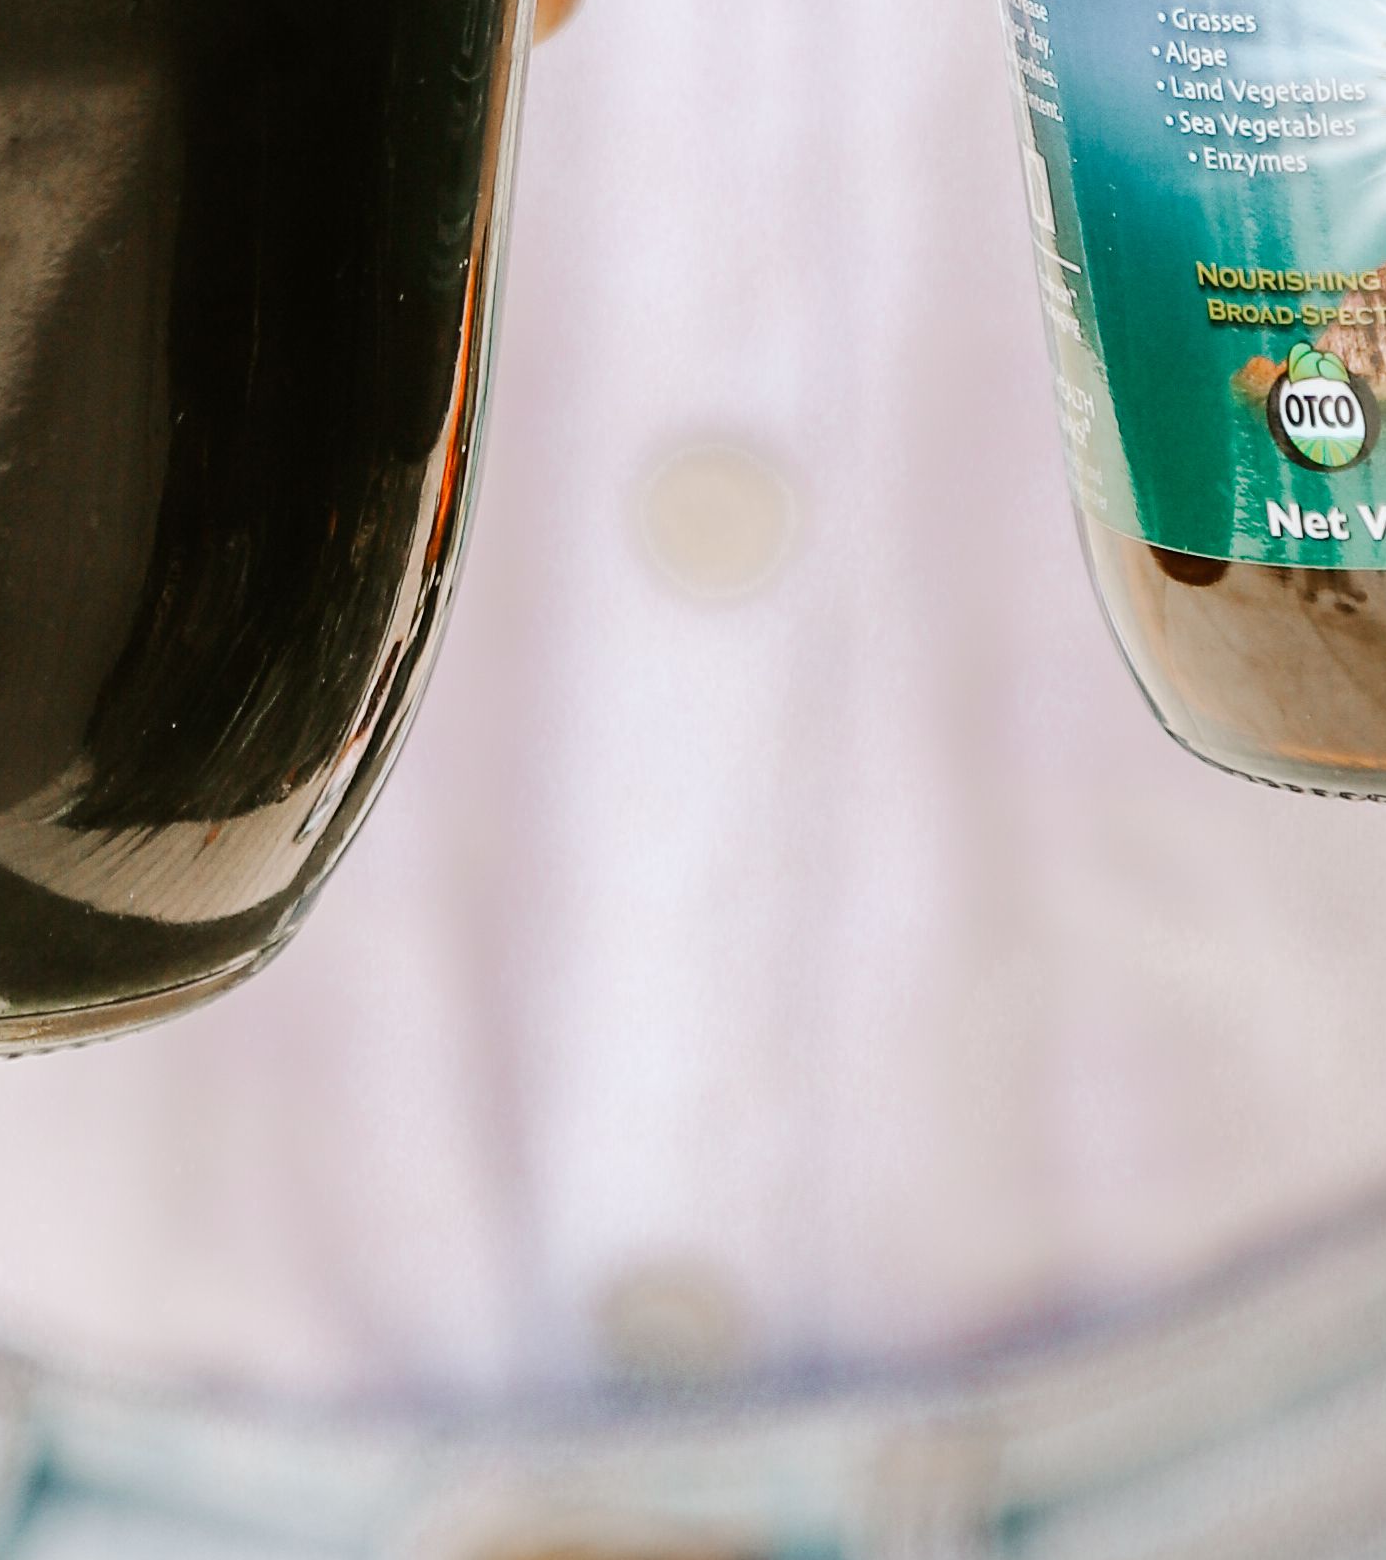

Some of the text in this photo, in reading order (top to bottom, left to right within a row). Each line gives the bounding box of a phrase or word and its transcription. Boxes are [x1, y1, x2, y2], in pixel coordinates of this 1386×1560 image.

[1171, 7, 1257, 33] Grasses
[1165, 40, 1228, 72] Algae
[1170, 75, 1366, 109] Land Vegetables
[1179, 110, 1357, 144] Sea Vegetables
[1203, 146, 1308, 178] Enzymes
[1195, 260, 1382, 293] NOURISHING
[1285, 393, 1355, 428] OTCO
[1266, 500, 1350, 542] Net
